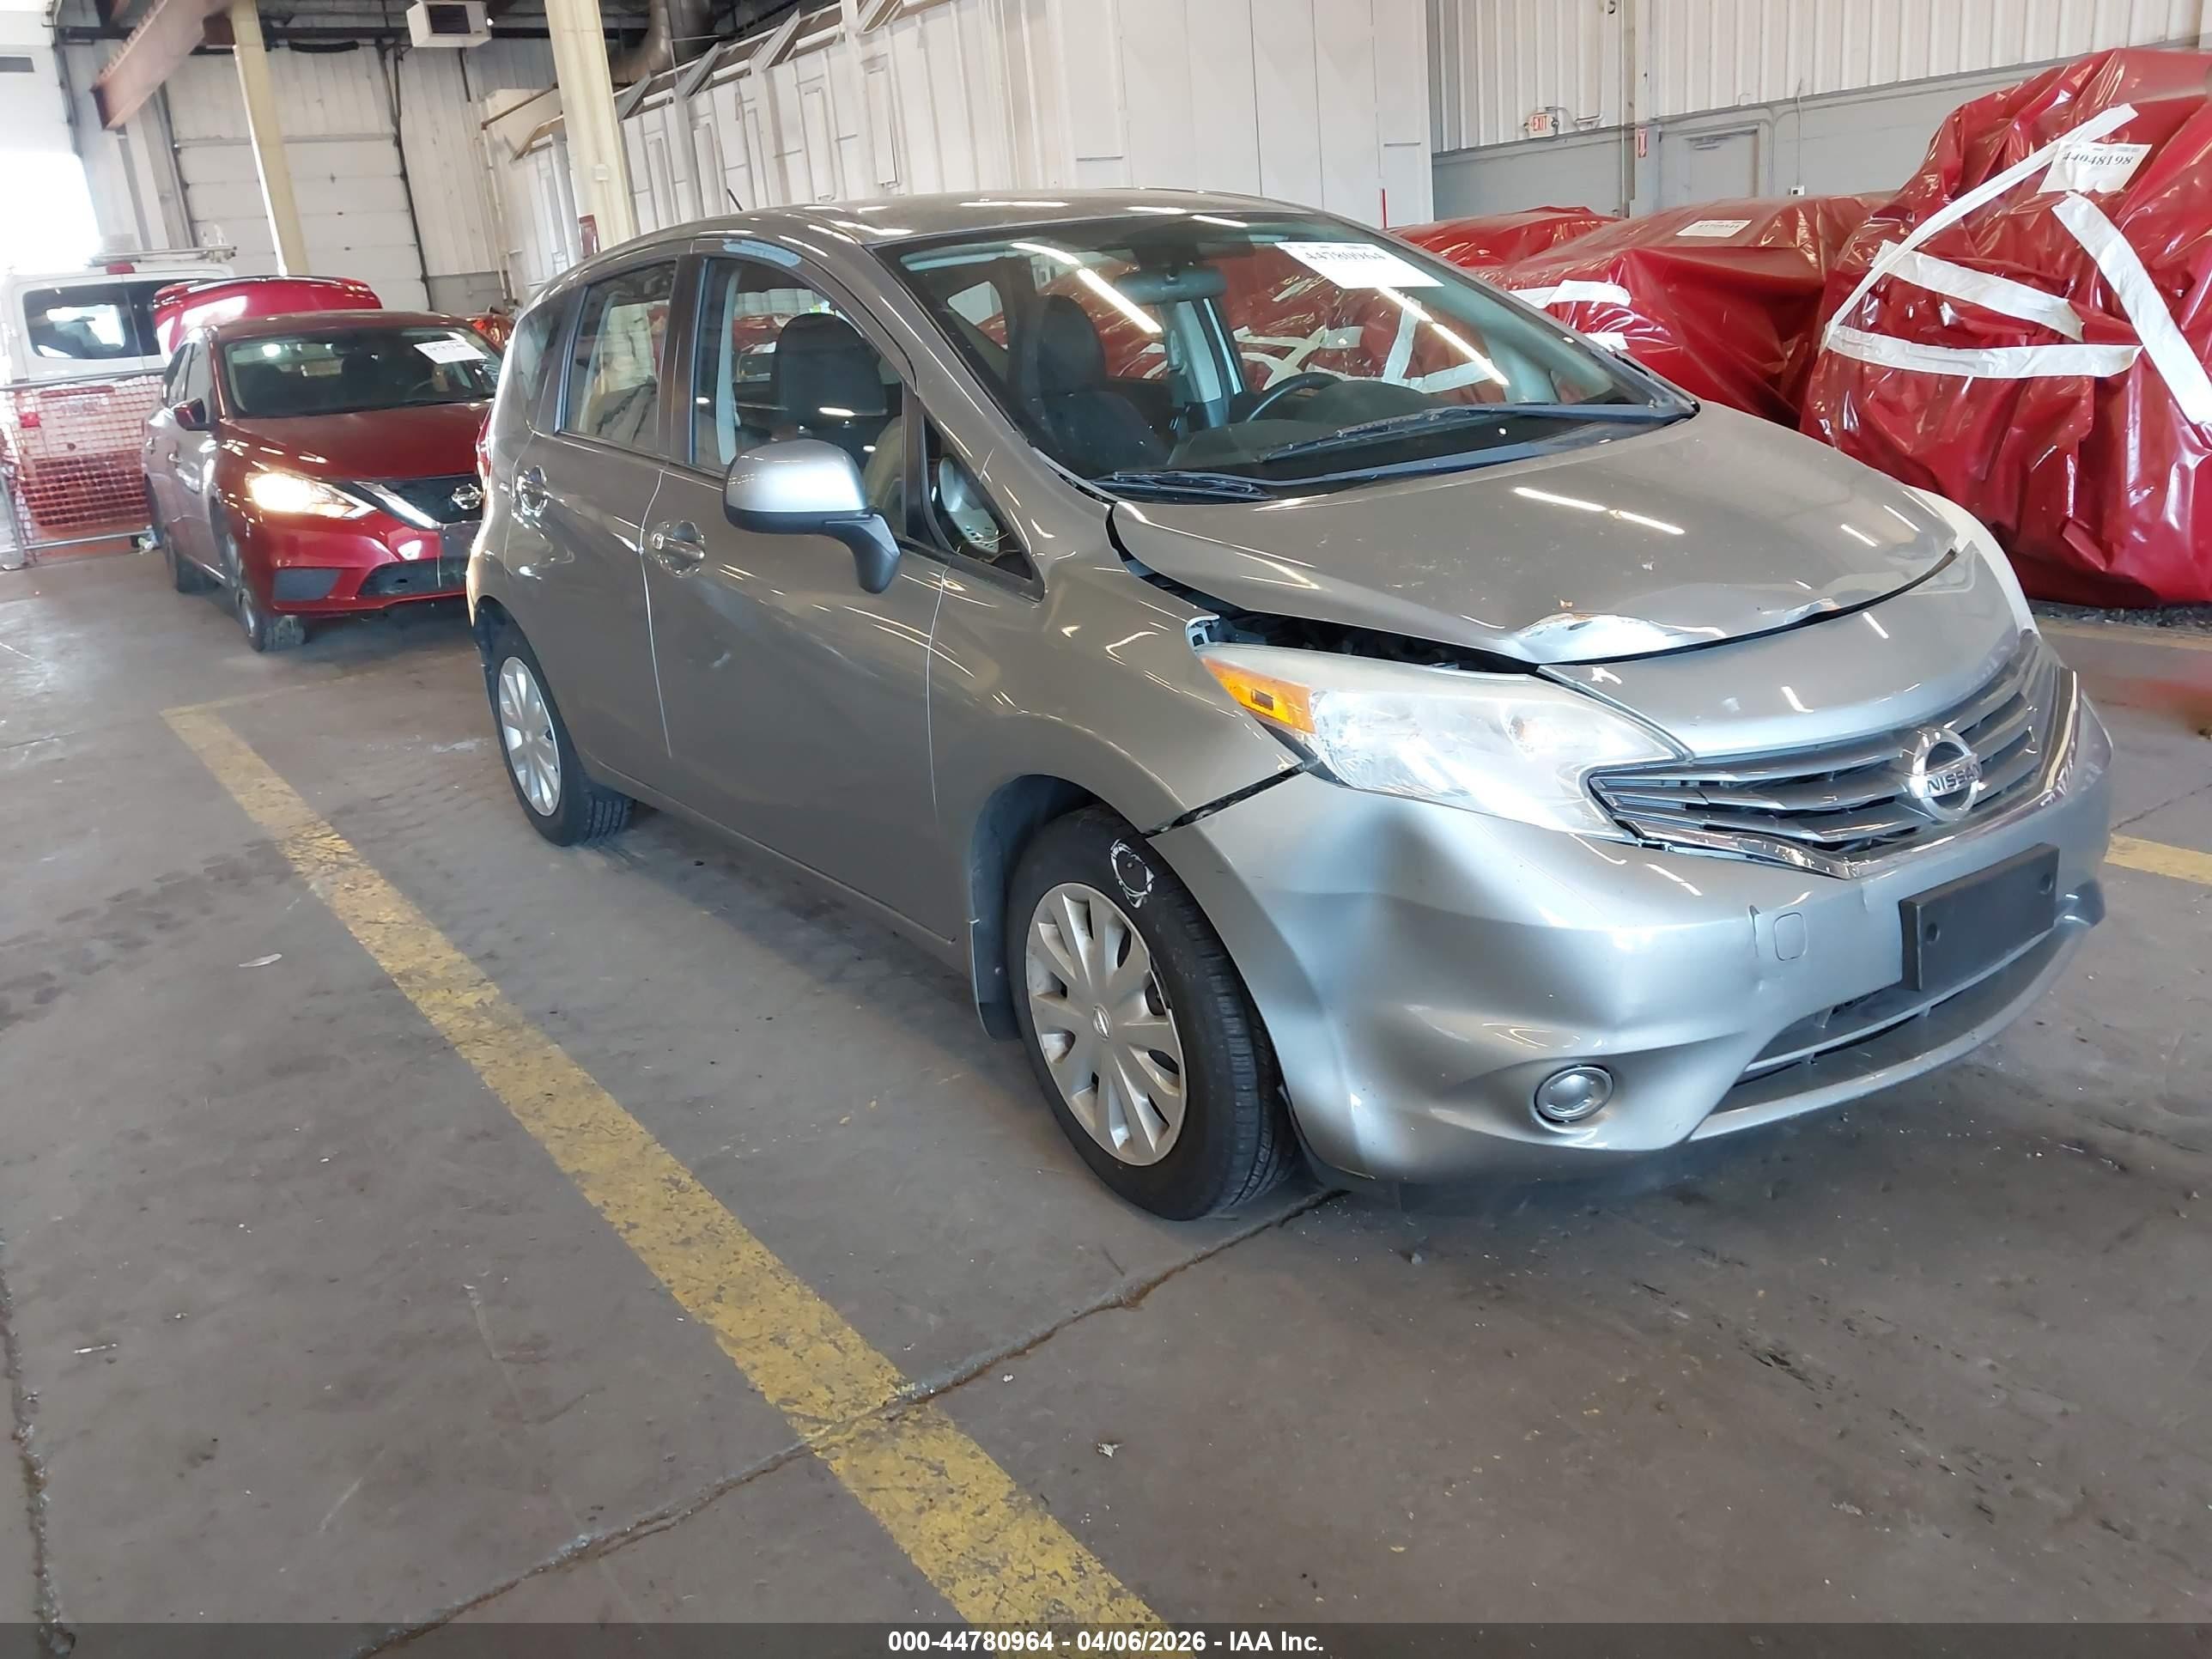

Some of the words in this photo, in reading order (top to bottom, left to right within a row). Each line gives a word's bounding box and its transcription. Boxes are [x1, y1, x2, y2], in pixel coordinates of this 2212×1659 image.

[1533, 116, 1547, 131] EXIT
[2062, 151, 2134, 166] 44048198
[1927, 763, 1980, 793] NISSAN
